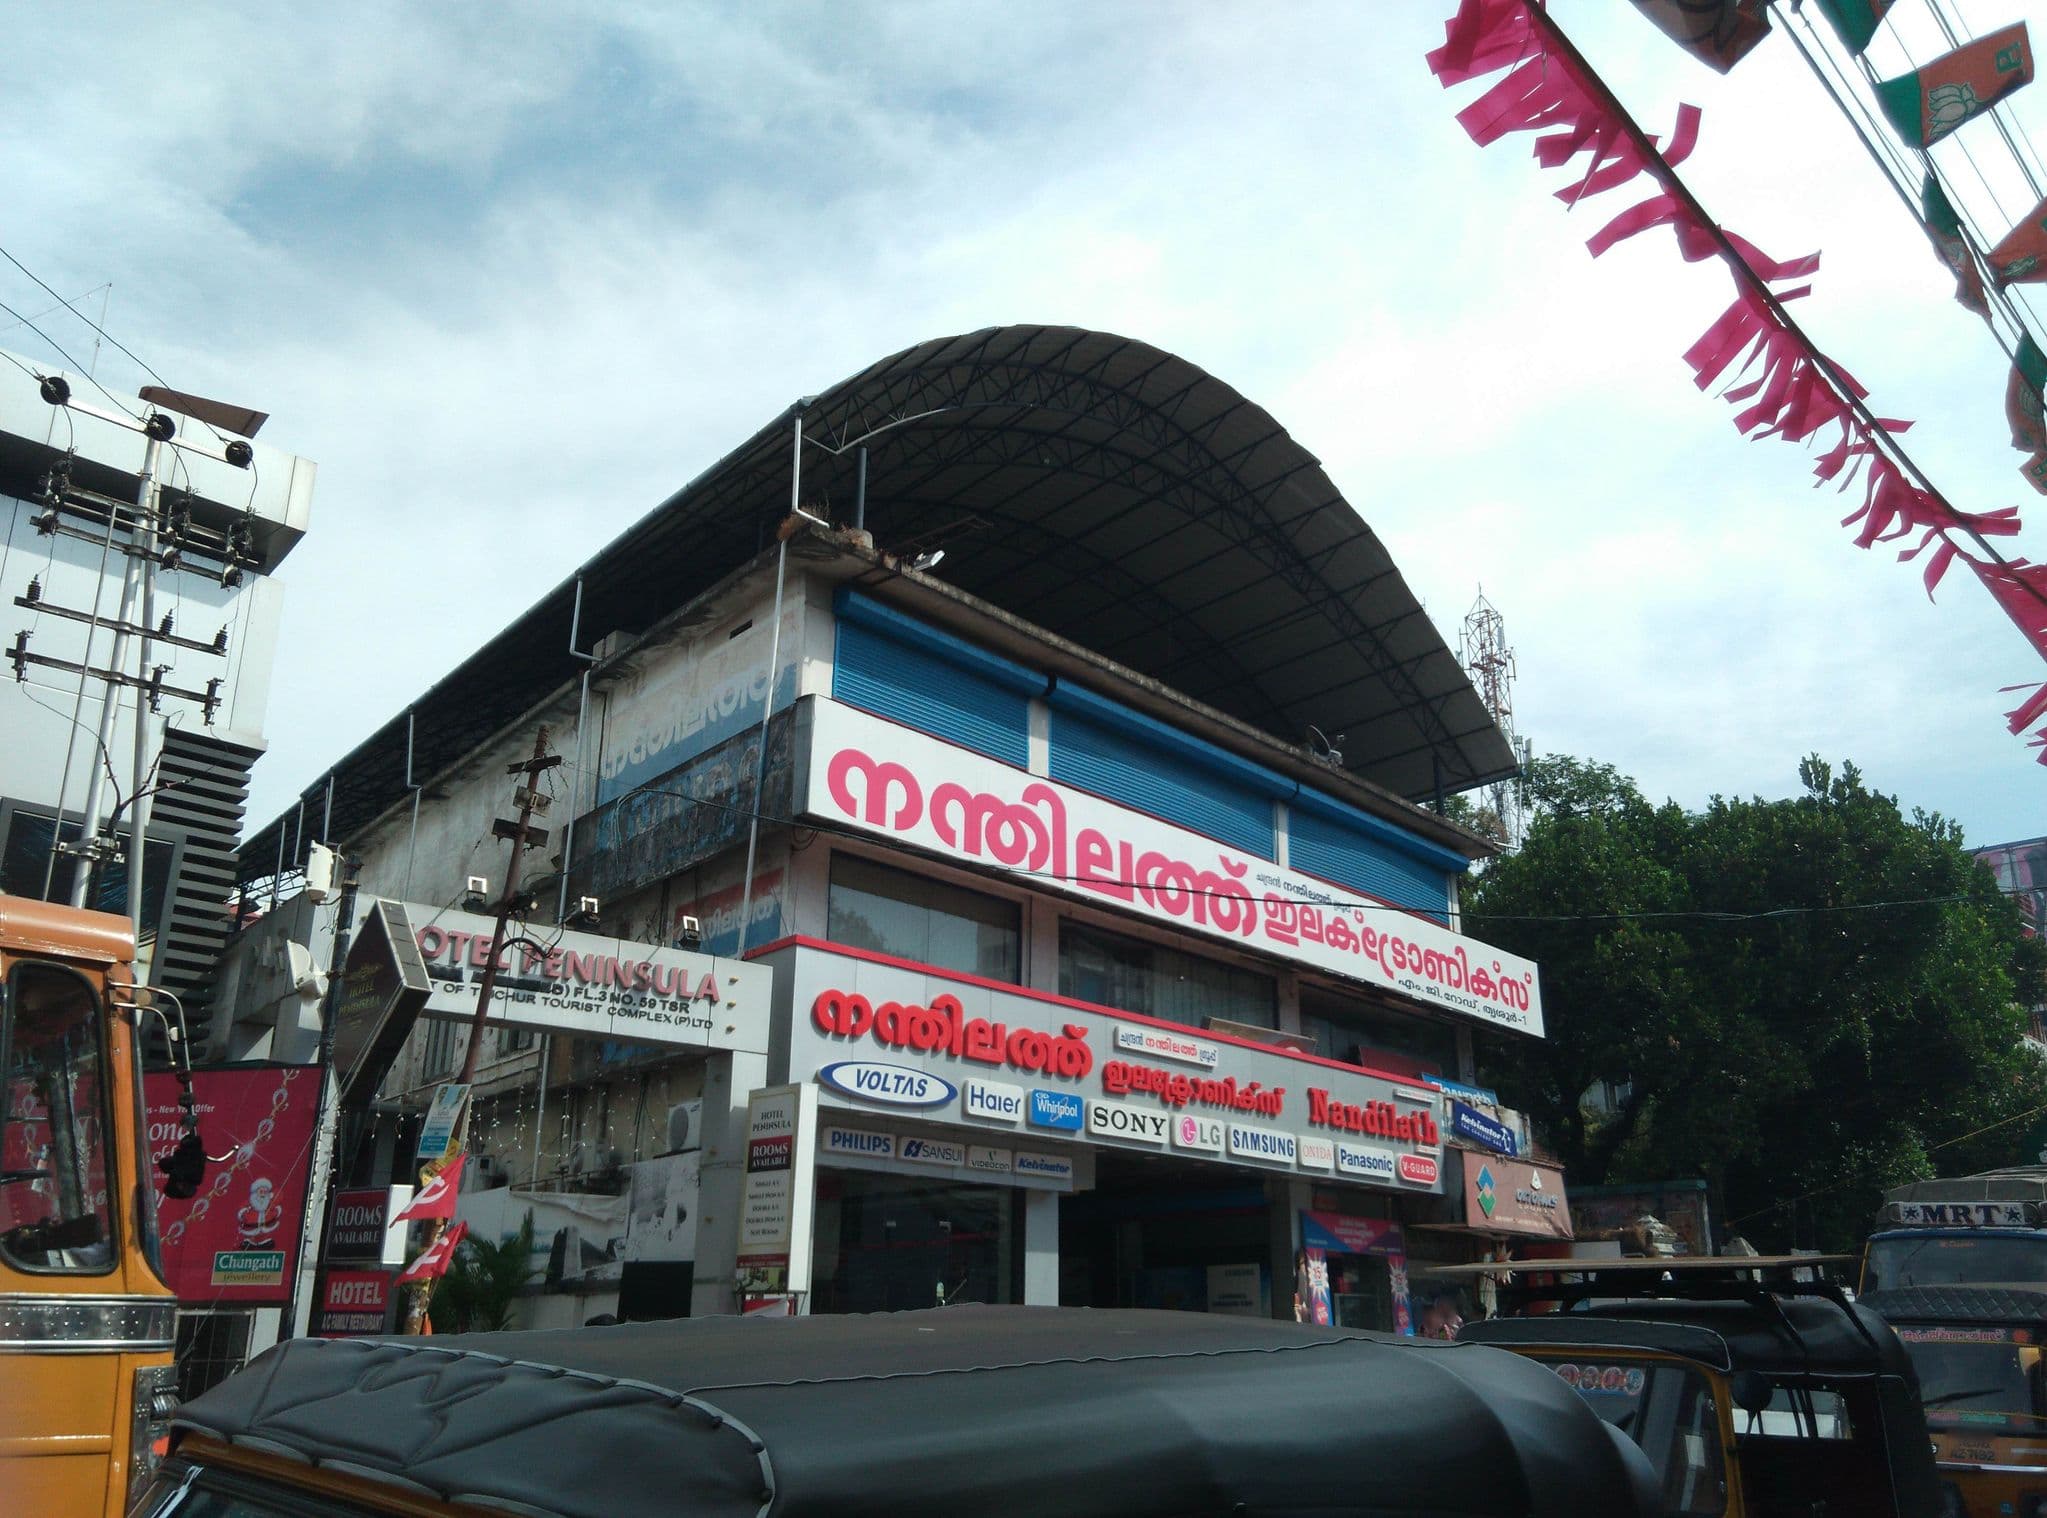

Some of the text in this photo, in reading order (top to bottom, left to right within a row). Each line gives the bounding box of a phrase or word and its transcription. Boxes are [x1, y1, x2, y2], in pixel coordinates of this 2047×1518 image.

[827, 747, 1258, 938] നന്തിലത്ത്
[414, 924, 721, 1003] OTEL PENINSULA
[542, 995, 601, 1015] TOURIST
[607, 1006, 672, 1025] COMPLEX
[812, 988, 1094, 1080] നന്തിലത്ത്
[855, 1067, 1436, 1177] VOLTAS Haier Whirlpool SONY LG SAMSUNG ONIDA Panasonic V-GUARD
[1307, 1086, 1440, 1146] Nandilath
[752, 1142, 789, 1158] ROOMS
[752, 1156, 787, 1169] AVAILABLE
[831, 1130, 891, 1153] PHILIPS
[921, 1144, 963, 1162] SANSUI
[1018, 1157, 1070, 1175] Kelvinator
[335, 1204, 383, 1227] ROOMS
[1919, 1203, 2001, 1226] MRT
[332, 1230, 380, 1245] AVAILABLE
[218, 1253, 280, 1271] Chungath
[329, 1281, 383, 1305] HOTEL
